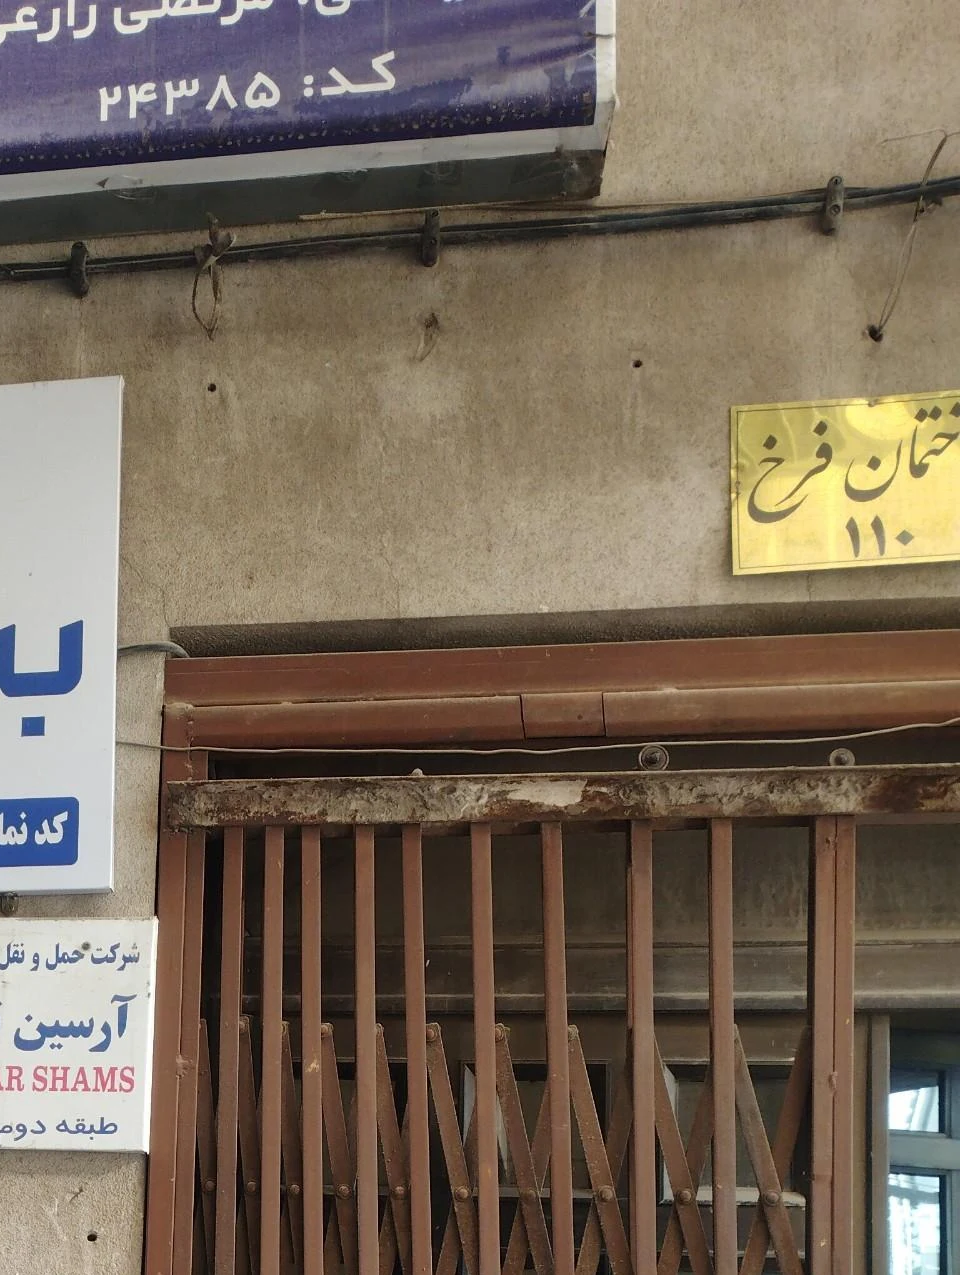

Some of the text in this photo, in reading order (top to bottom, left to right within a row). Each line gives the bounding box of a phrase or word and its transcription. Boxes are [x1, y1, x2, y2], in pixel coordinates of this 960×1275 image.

[99, 72, 282, 123] ۲۴۳۸۵
[747, 420, 833, 523] فرخ
[845, 514, 915, 558] ۱۱۰
[34, 811, 69, 845] کد
[30, 951, 40, 971] و
[45, 942, 85, 970] حمل
[90, 942, 140, 971] شرکت
[13, 994, 138, 1053] آرسین
[31, 1066, 135, 1093] SHAMS
[55, 1116, 118, 1141] طبقه
